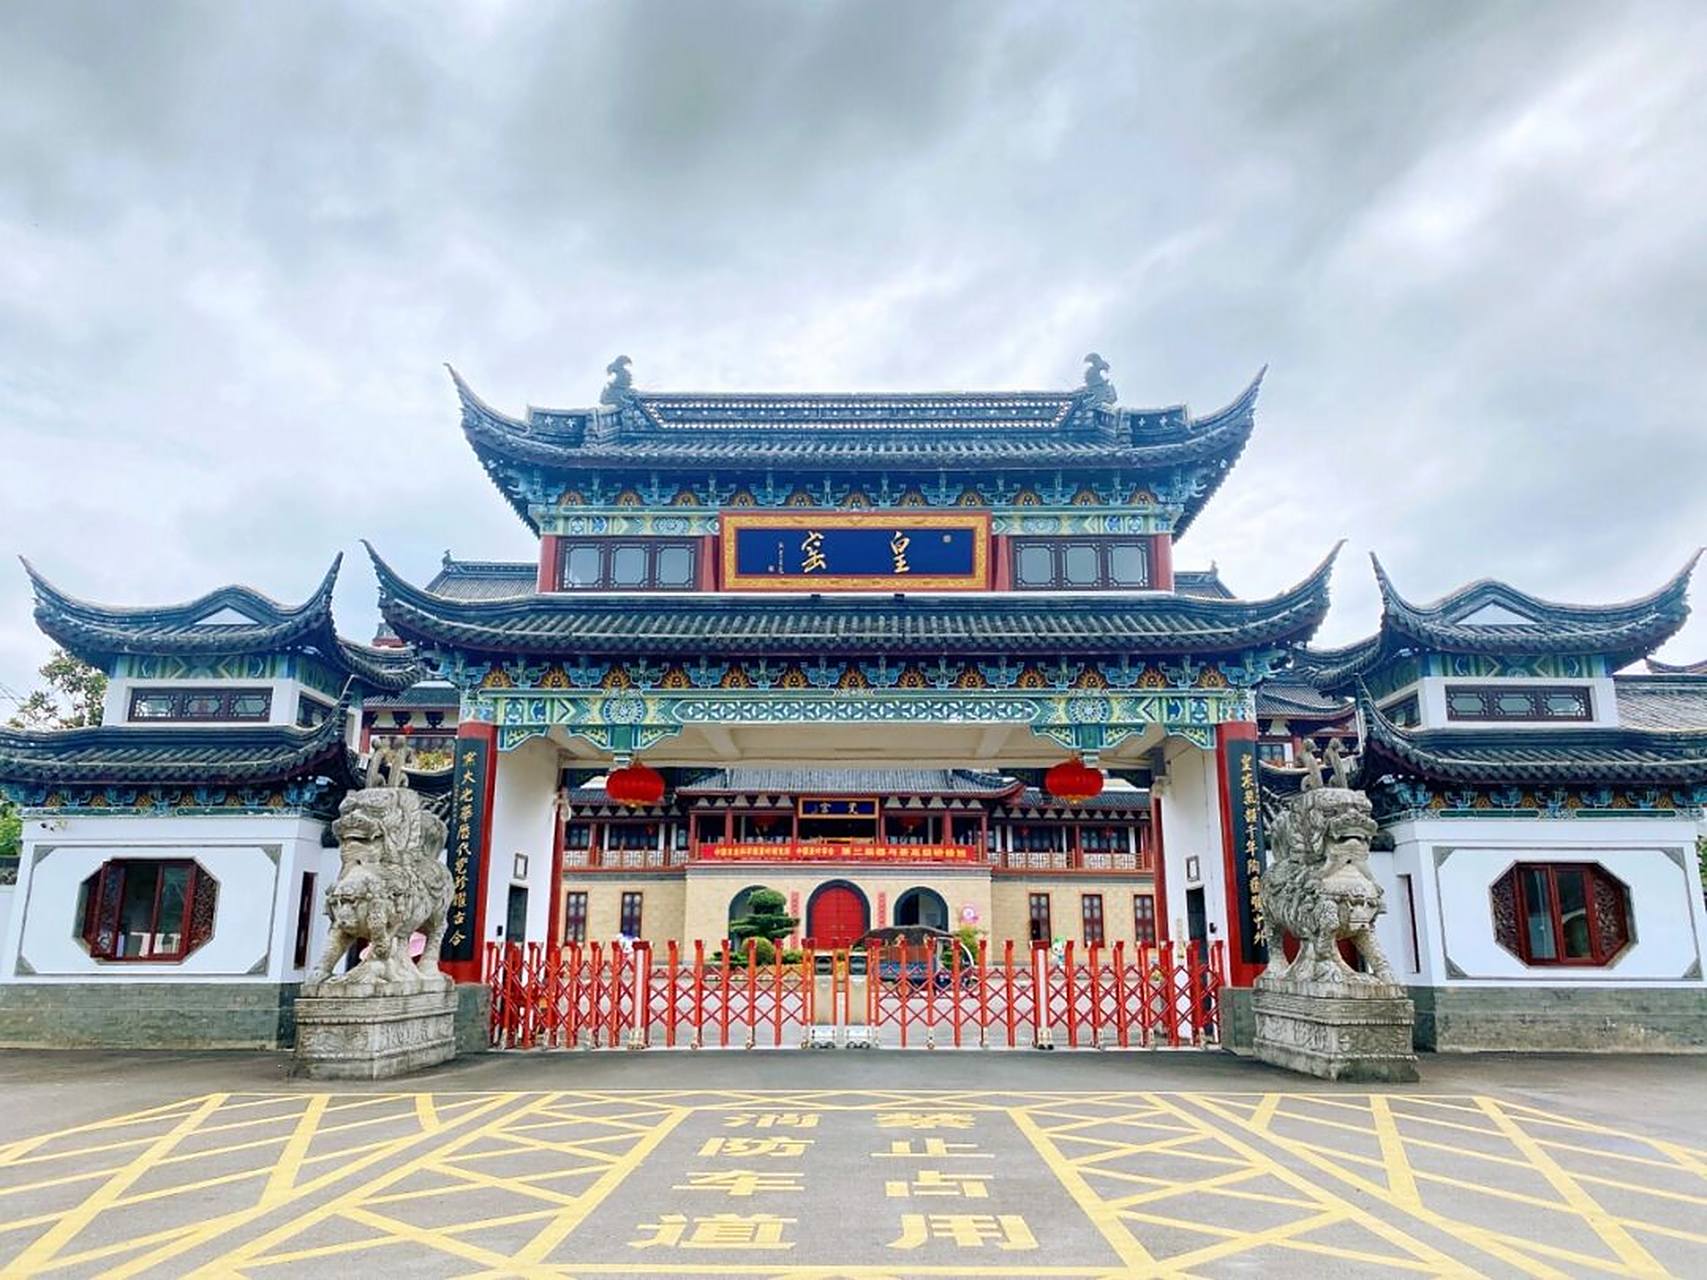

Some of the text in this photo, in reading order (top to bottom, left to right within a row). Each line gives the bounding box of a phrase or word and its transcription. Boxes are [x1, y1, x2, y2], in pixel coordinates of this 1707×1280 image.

[627, 1112, 822, 1249] 消防车道
[870, 1112, 1041, 1250] 禁止占用
